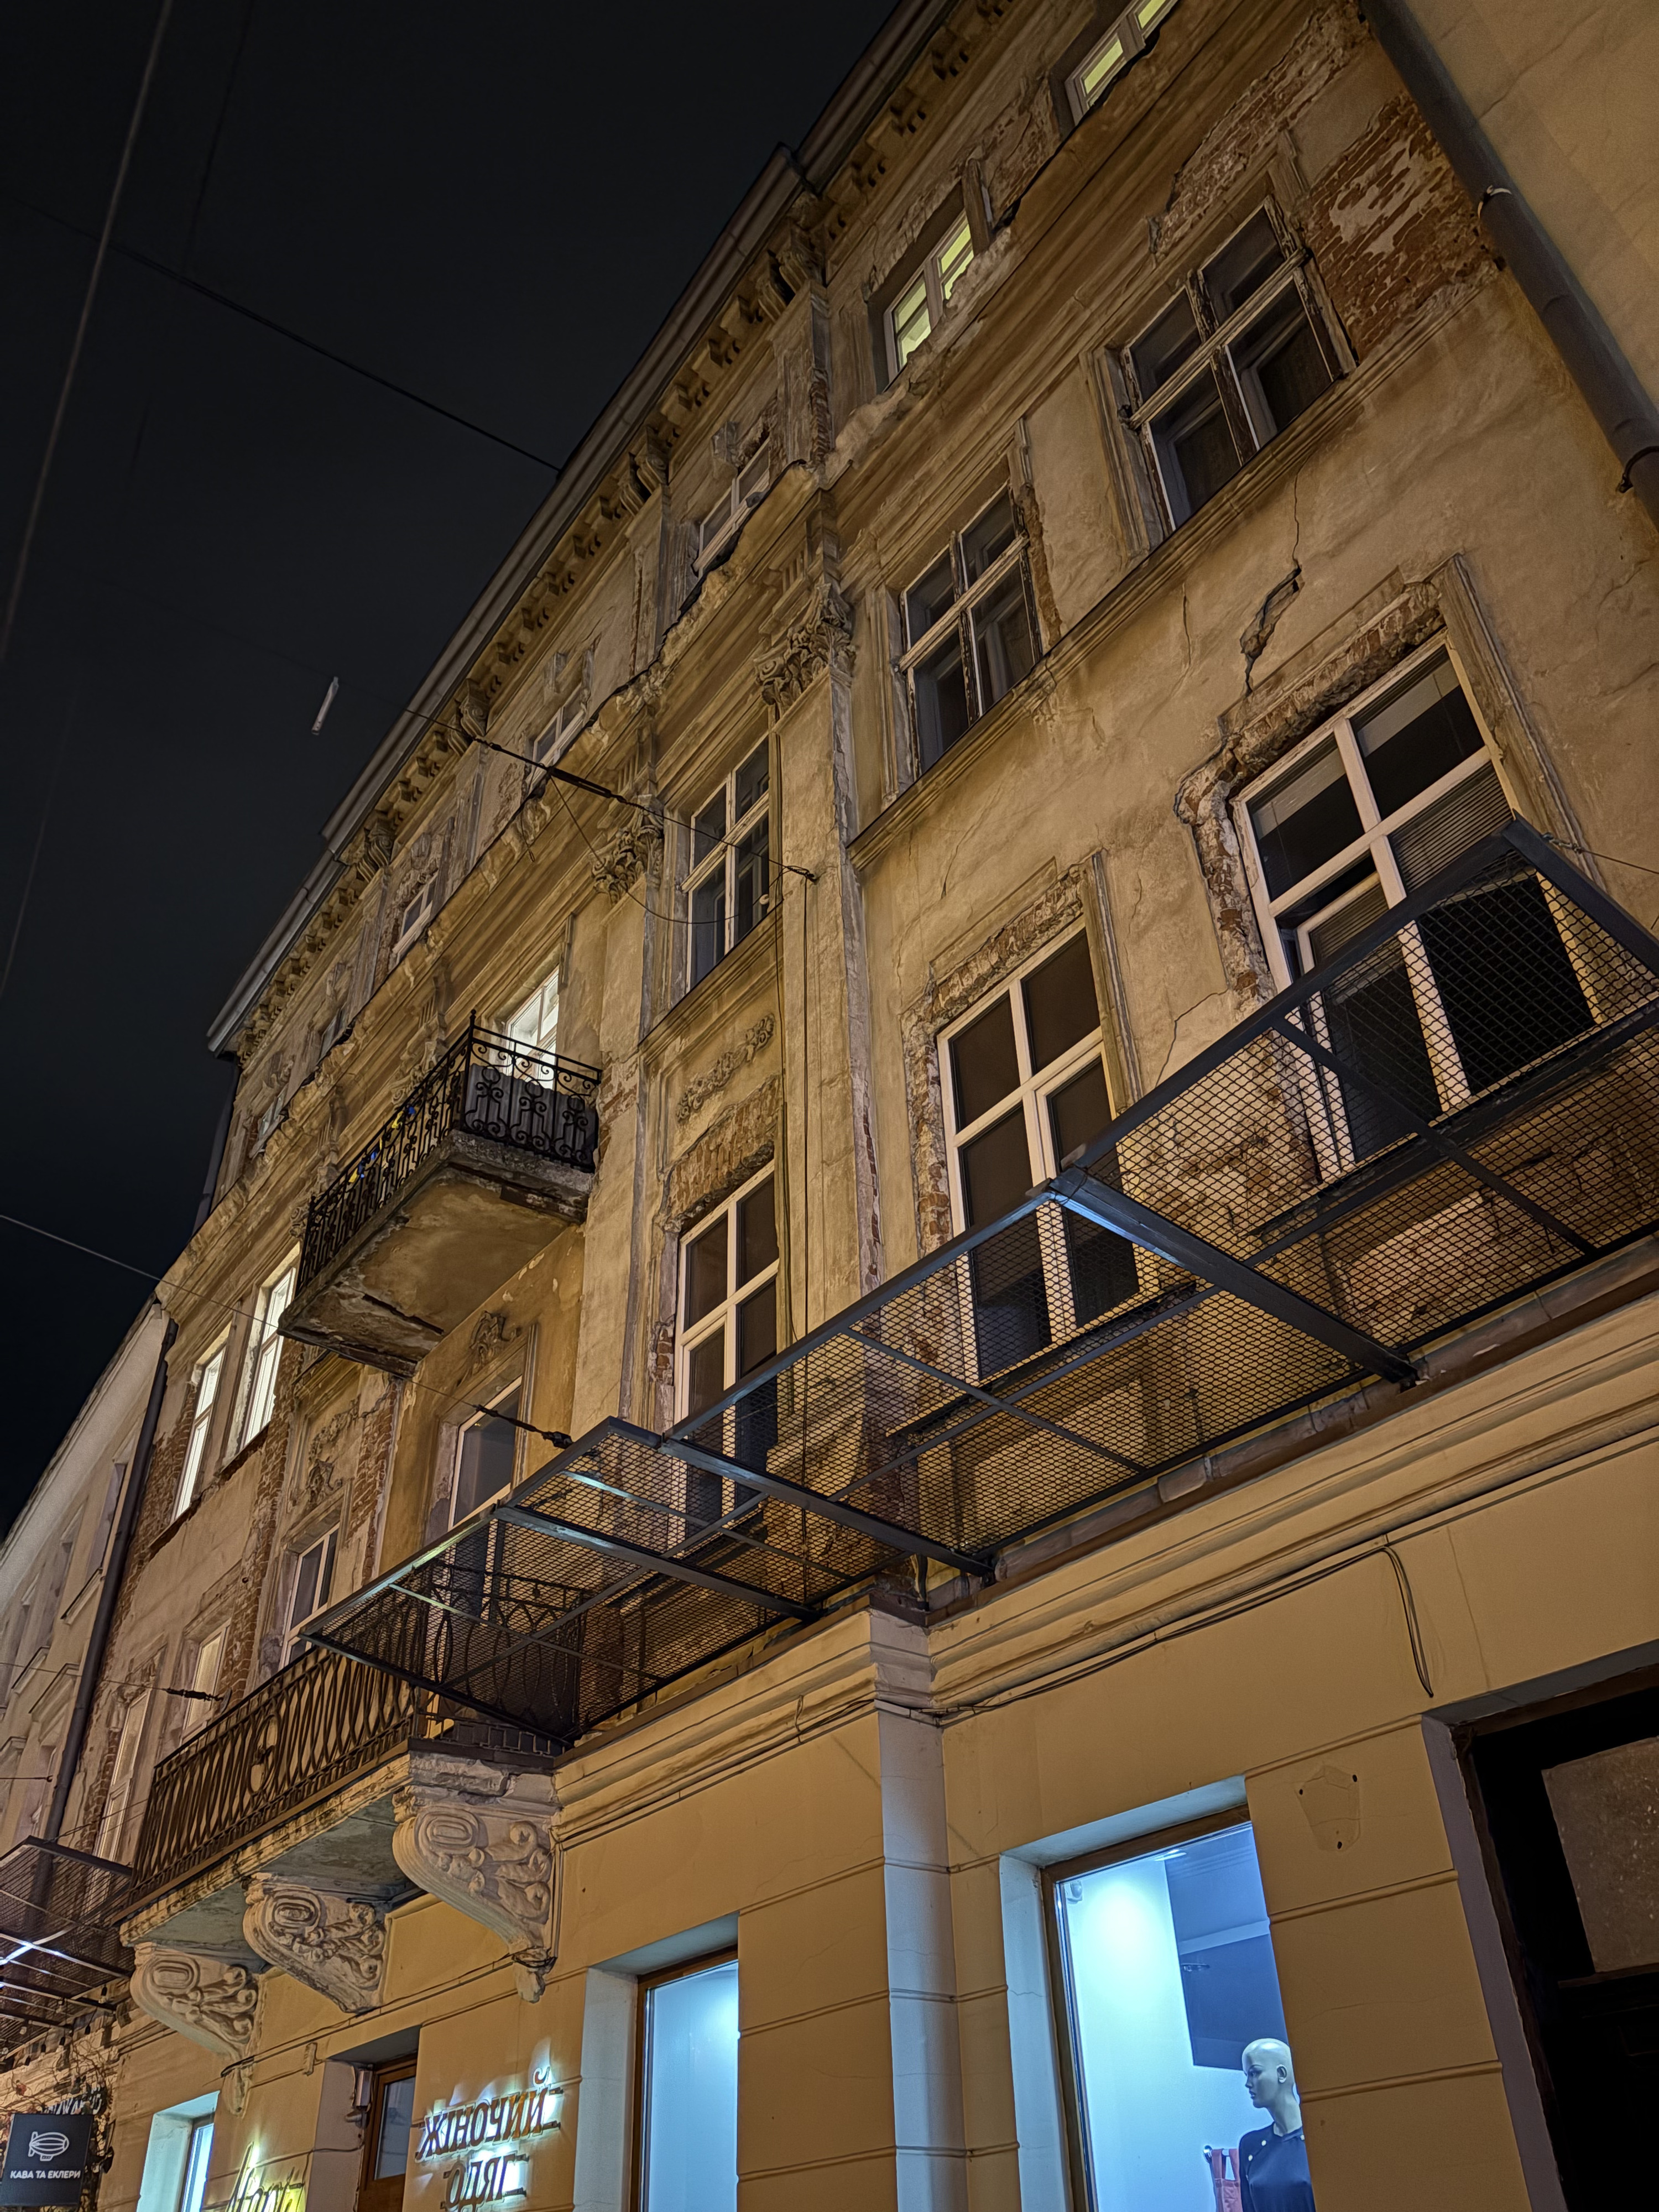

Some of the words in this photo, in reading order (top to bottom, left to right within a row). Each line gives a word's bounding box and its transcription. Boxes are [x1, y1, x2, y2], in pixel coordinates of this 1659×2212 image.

[416, 2067, 551, 2161] ЖІНОЧИЙ
[10, 2170, 34, 2179] КАВА
[35, 2170, 46, 2179] ТА
[48, 2170, 81, 2179] ЕКЛЕРИ
[445, 2153, 517, 2212] ОДЯГ
